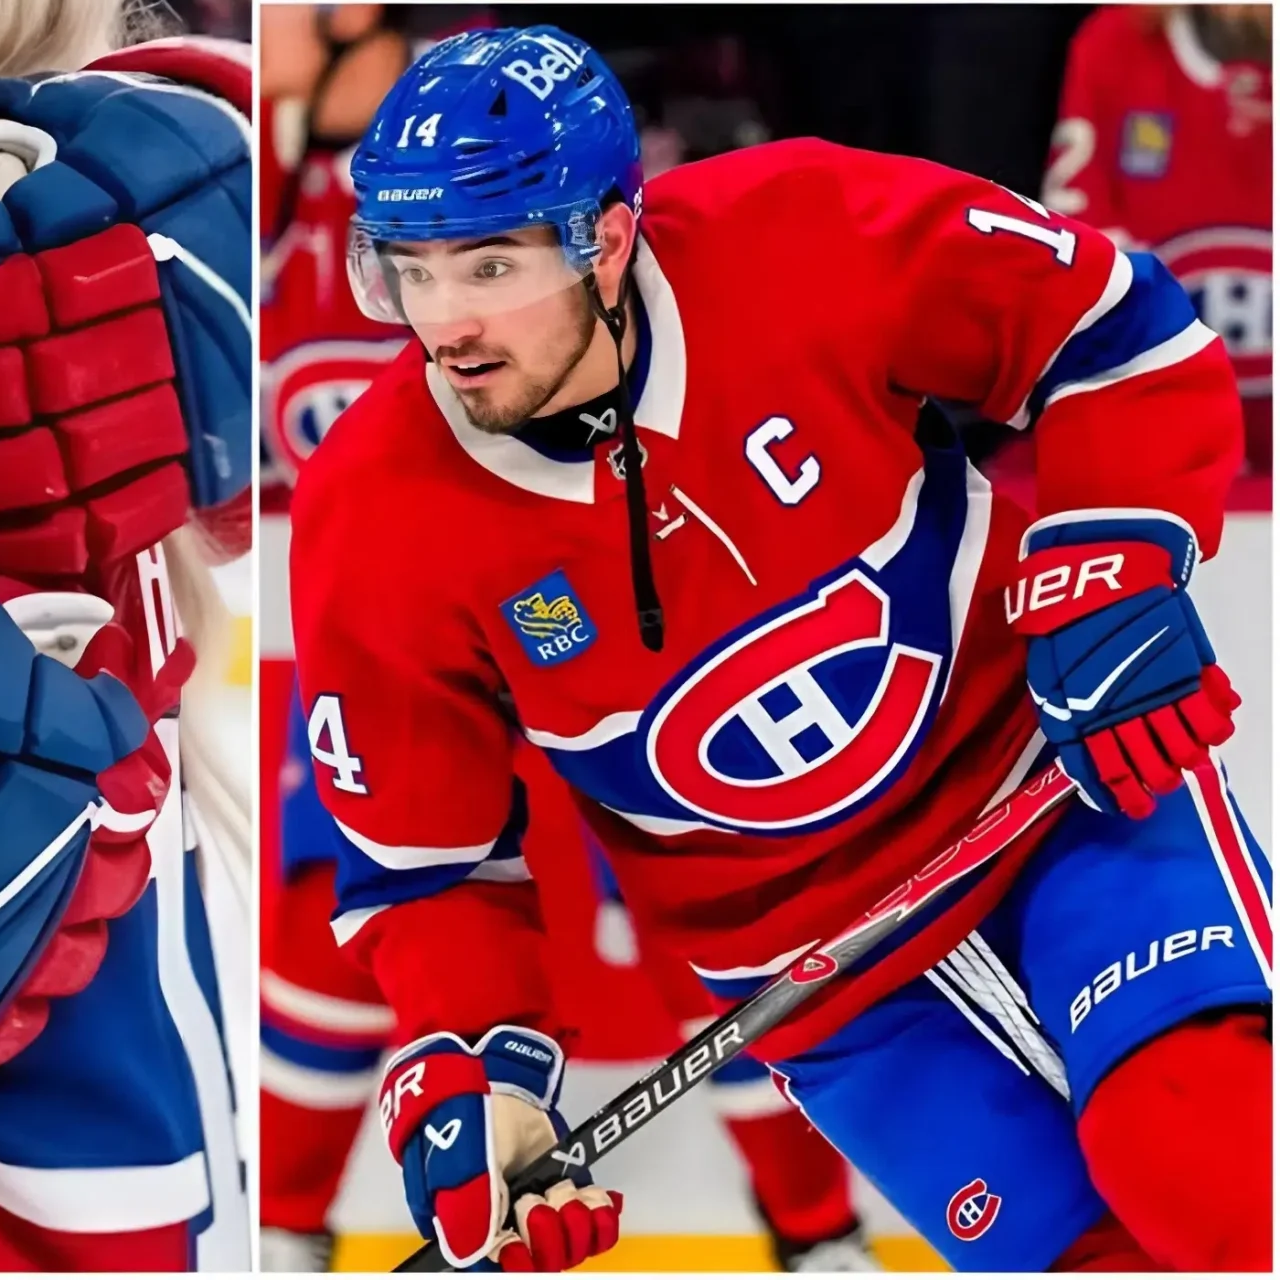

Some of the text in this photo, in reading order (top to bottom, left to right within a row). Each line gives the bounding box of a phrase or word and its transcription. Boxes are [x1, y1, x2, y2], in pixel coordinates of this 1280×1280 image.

[500, 33, 584, 102] Bell
[396, 113, 443, 148] 14
[744, 415, 821, 506] C
[536, 624, 590, 661] RBC
